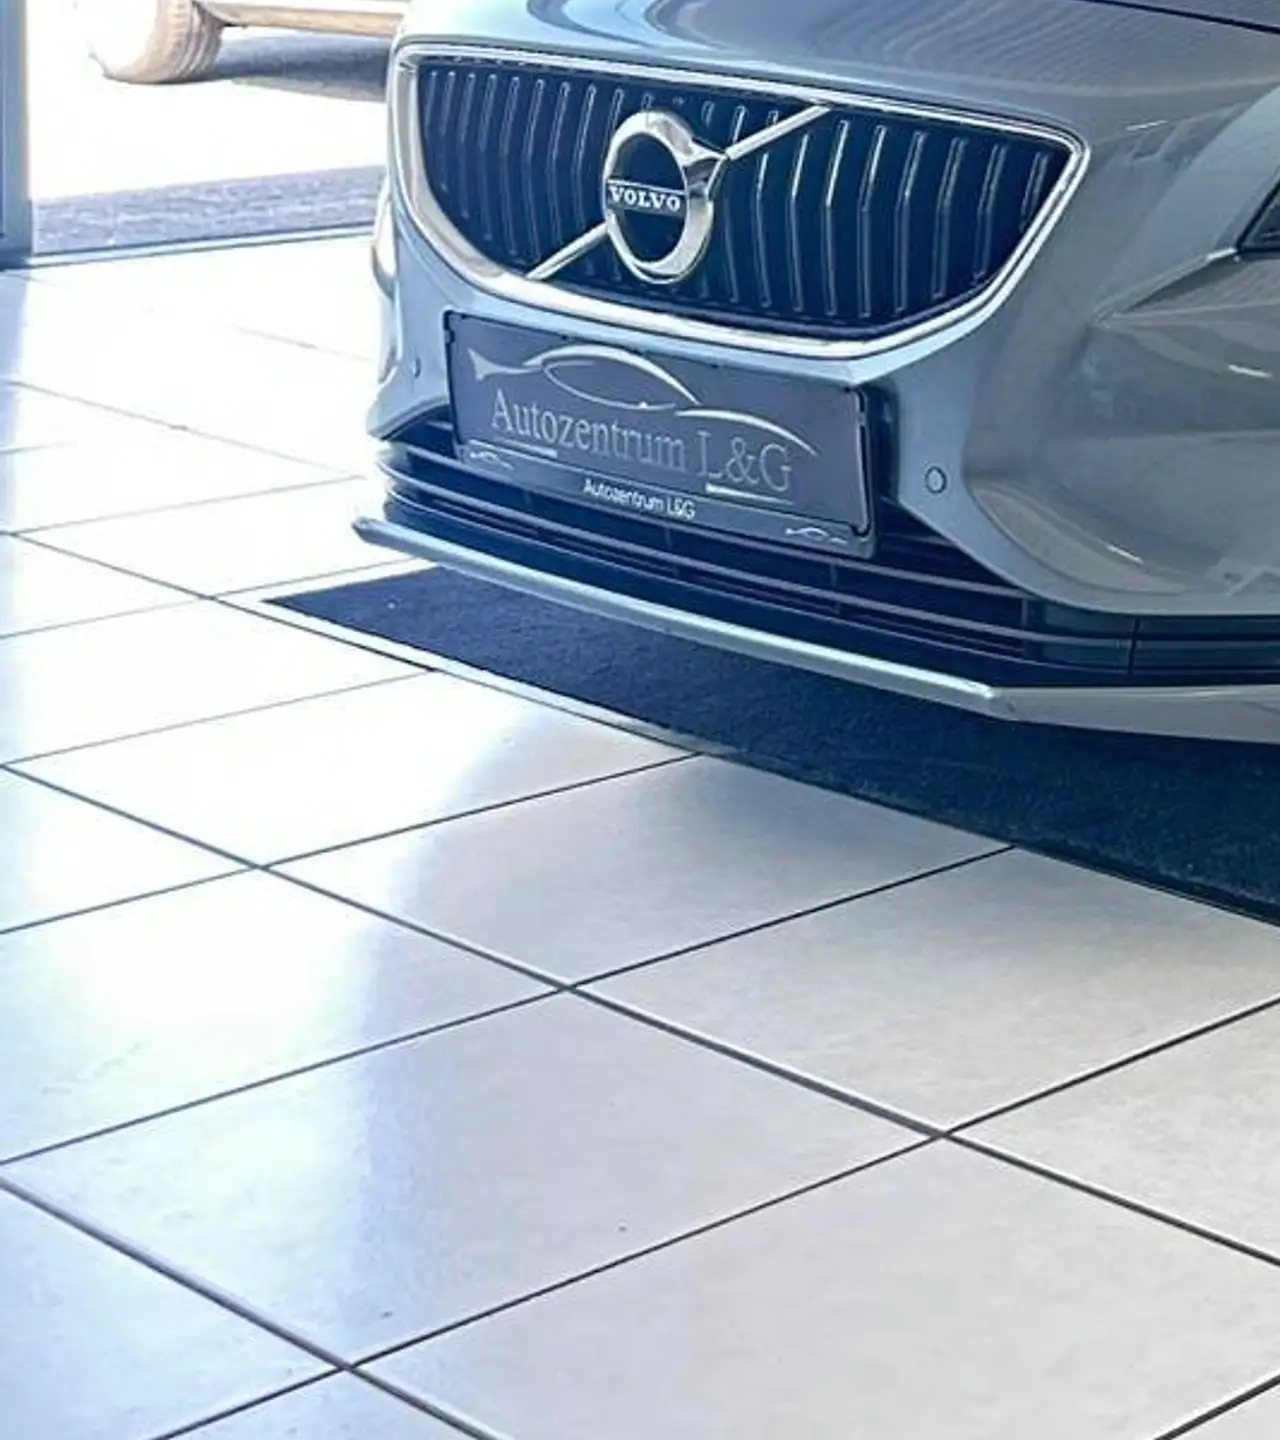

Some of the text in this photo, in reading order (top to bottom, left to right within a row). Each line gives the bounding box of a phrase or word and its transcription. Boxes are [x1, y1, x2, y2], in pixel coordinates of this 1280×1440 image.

[608, 185, 681, 212] VOLVO
[491, 388, 793, 493] Autozentrum L&G
[583, 478, 665, 510] Autozentrum
